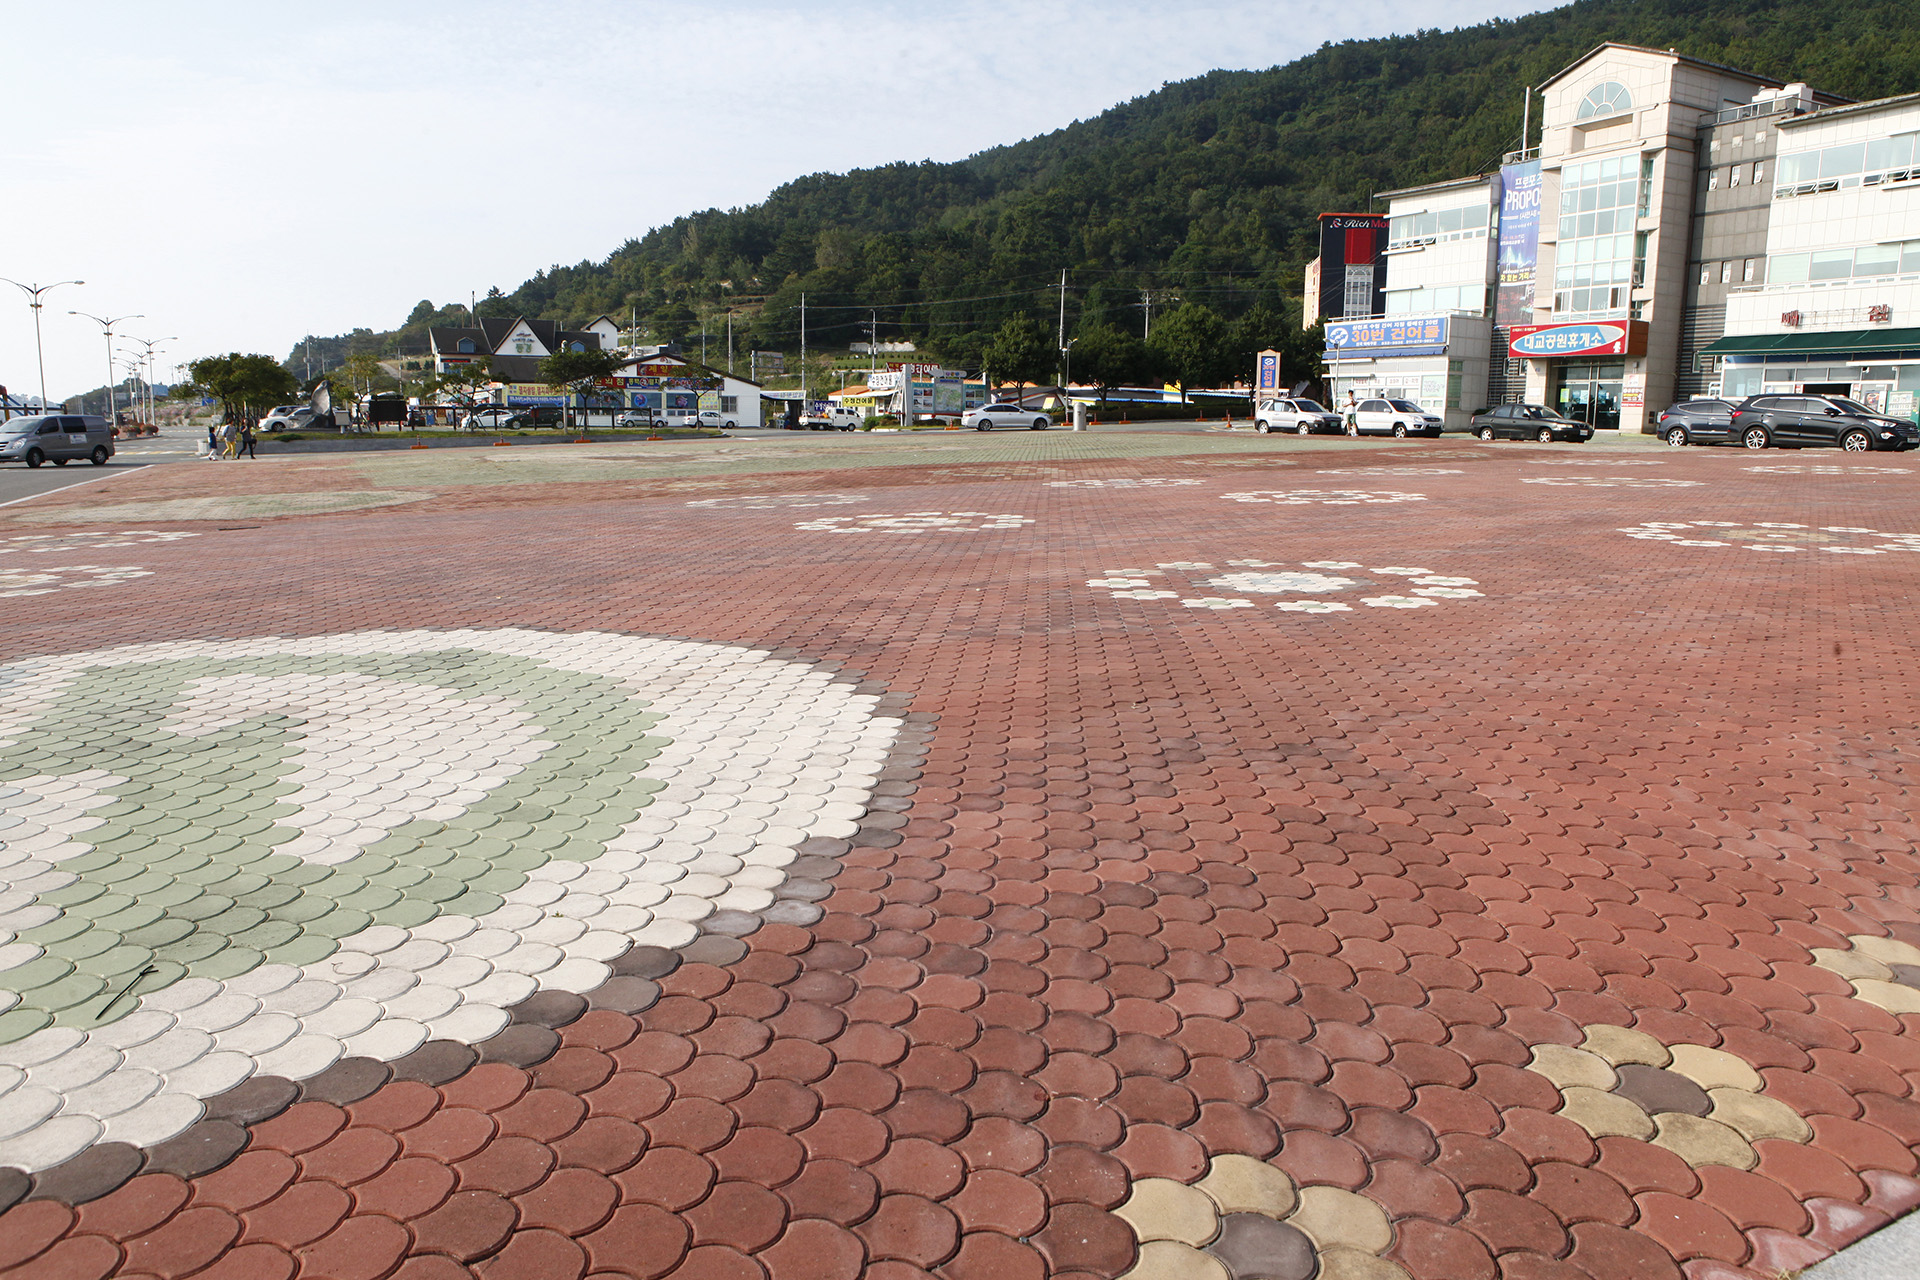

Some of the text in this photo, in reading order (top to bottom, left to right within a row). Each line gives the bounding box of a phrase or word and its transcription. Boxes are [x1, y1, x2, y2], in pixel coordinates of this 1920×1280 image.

[1505, 187, 1542, 211] PROPO
[1344, 219, 1370, 228] Rich
[1351, 325, 1440, 343] 30번 건어물
[1524, 332, 1602, 350] 대교공원휴게소
